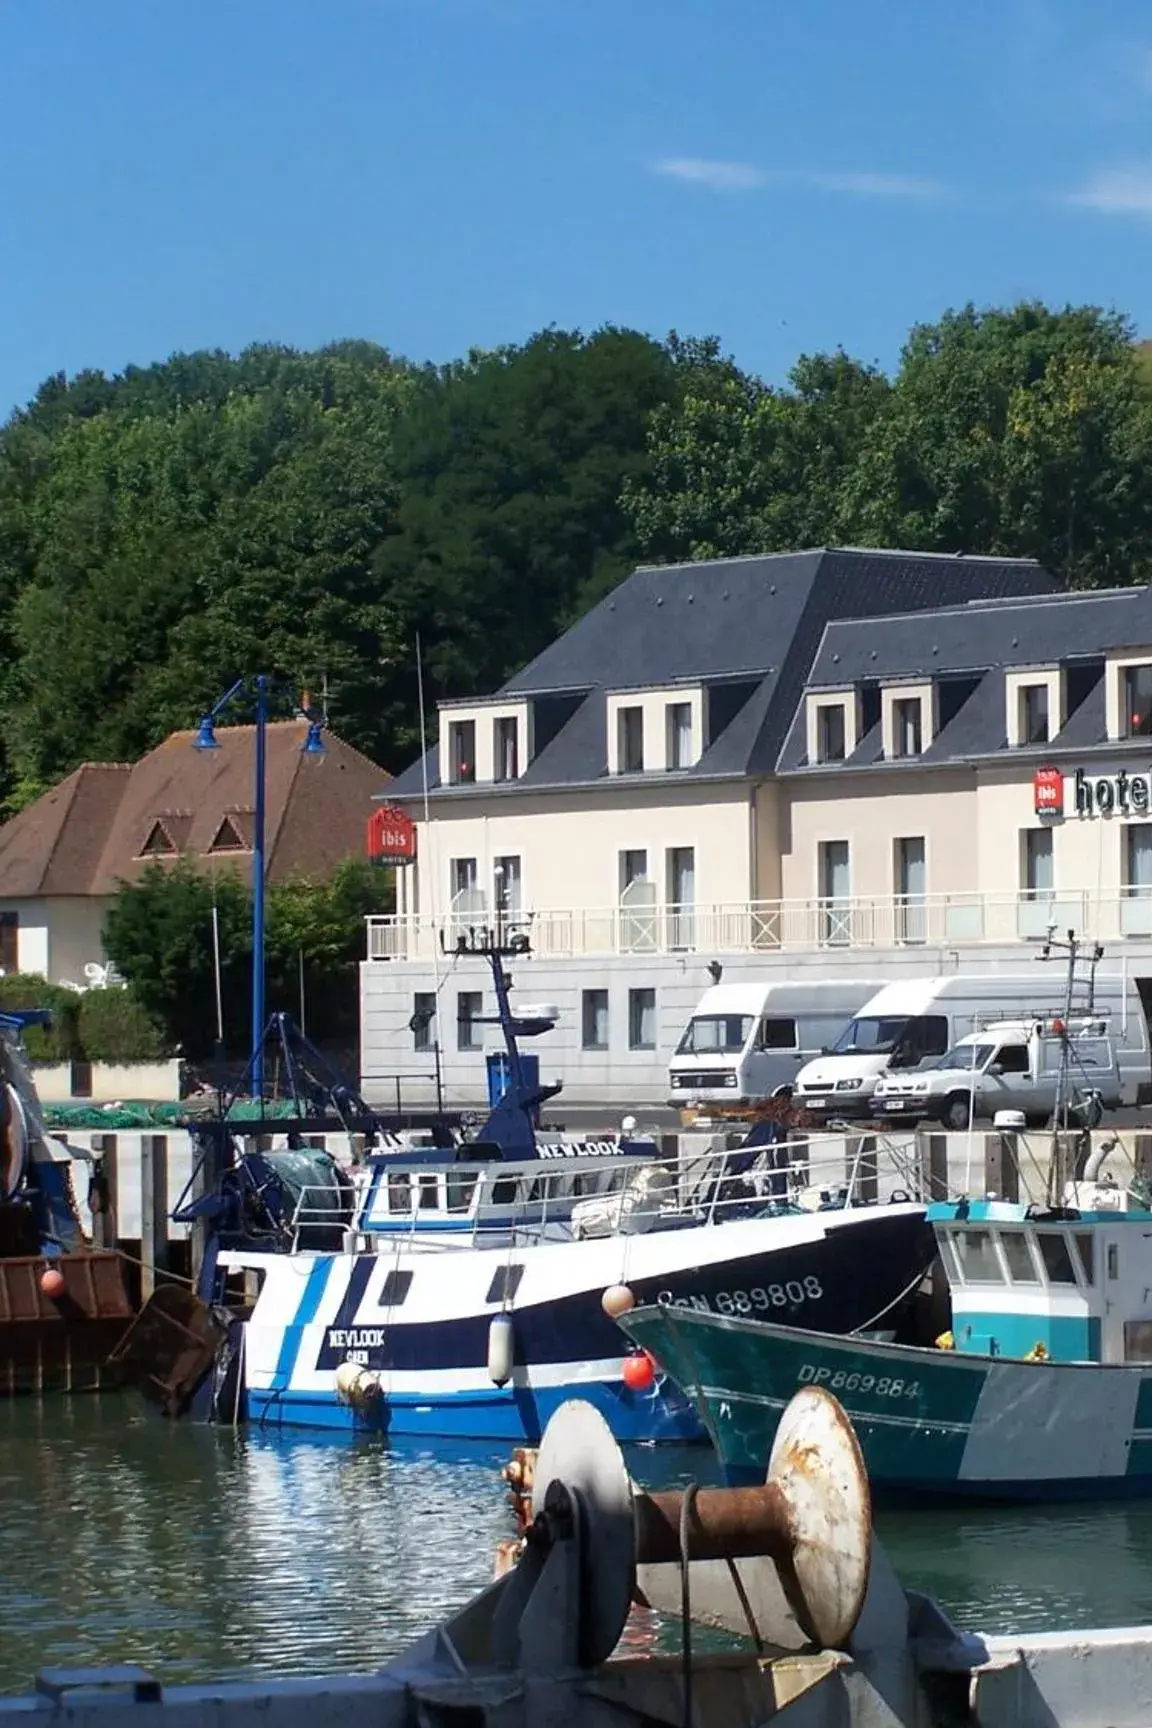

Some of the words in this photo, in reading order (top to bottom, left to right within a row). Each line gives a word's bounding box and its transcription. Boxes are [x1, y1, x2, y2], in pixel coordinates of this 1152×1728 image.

[382, 830, 406, 846] ibis
[536, 1141, 624, 1159] NEWLOOK
[715, 1275, 823, 1314] 689808
[797, 1363, 921, 1400] DP869884
